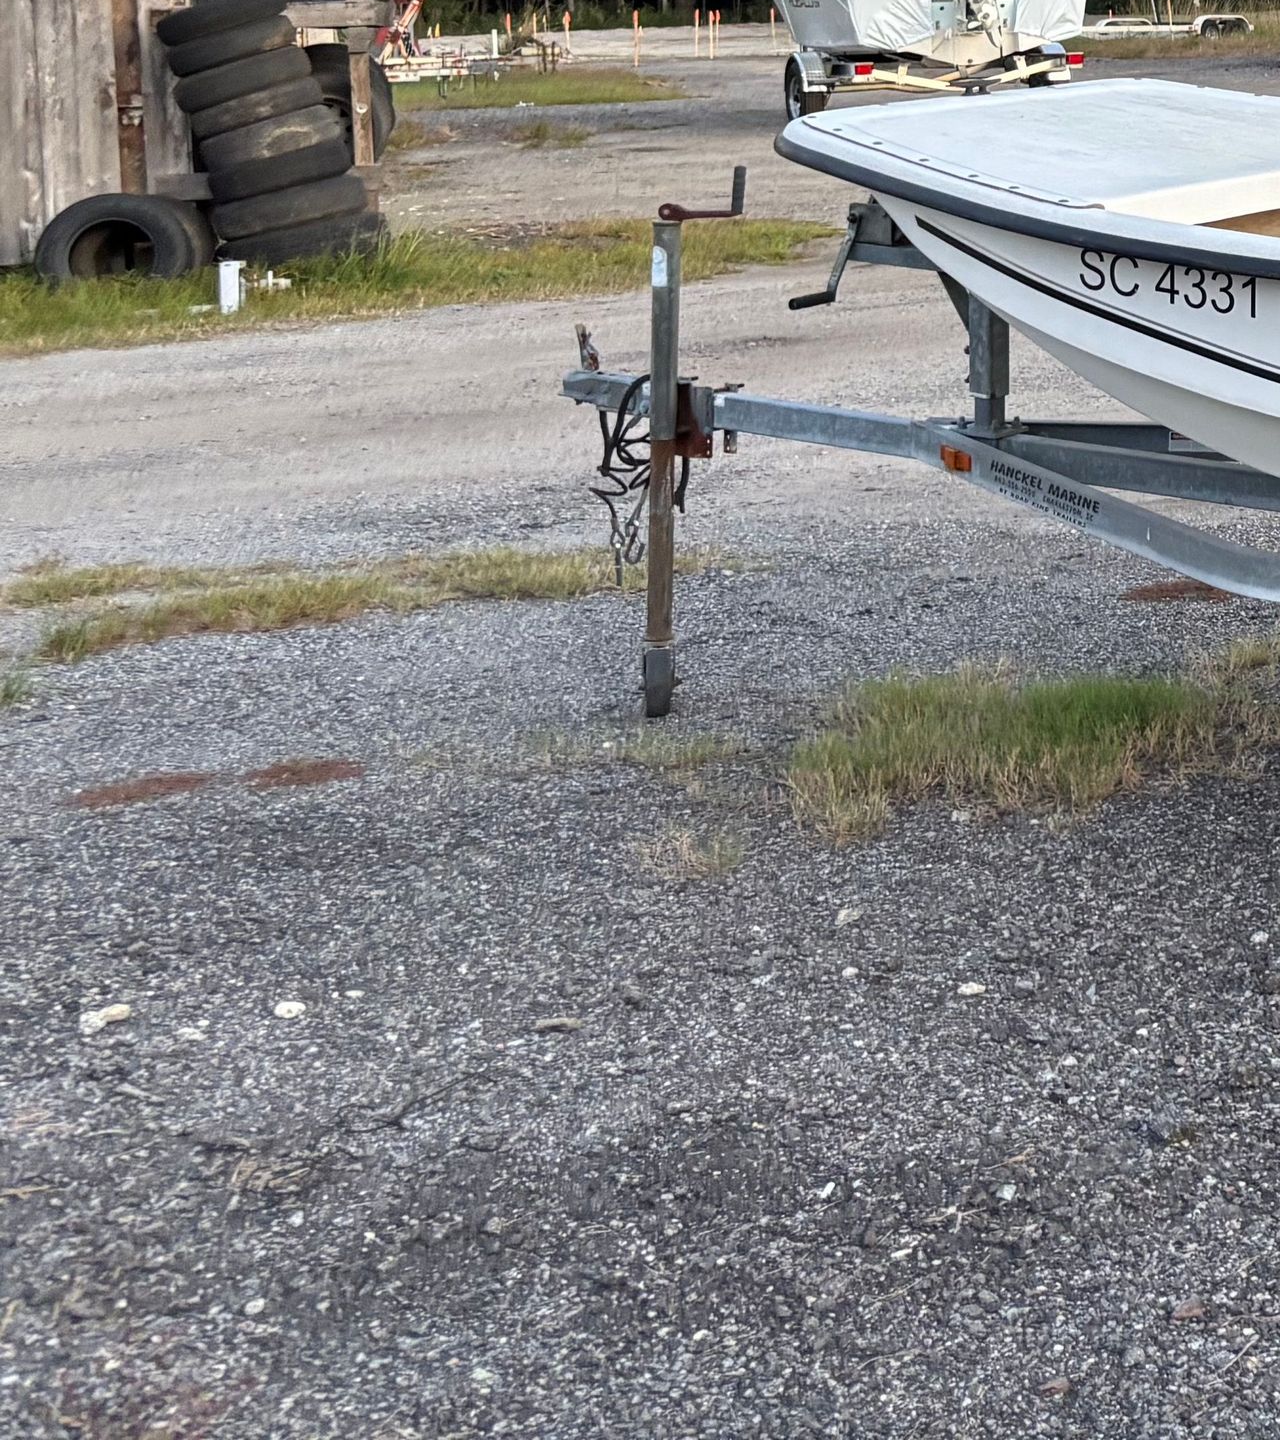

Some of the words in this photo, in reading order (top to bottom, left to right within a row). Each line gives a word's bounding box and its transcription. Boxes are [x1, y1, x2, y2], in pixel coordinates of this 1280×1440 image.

[1079, 248, 1139, 297] SC
[1155, 264, 1258, 319] 4331
[991, 460, 1043, 491] HANCKEL
[1048, 483, 1101, 514] MARINE
